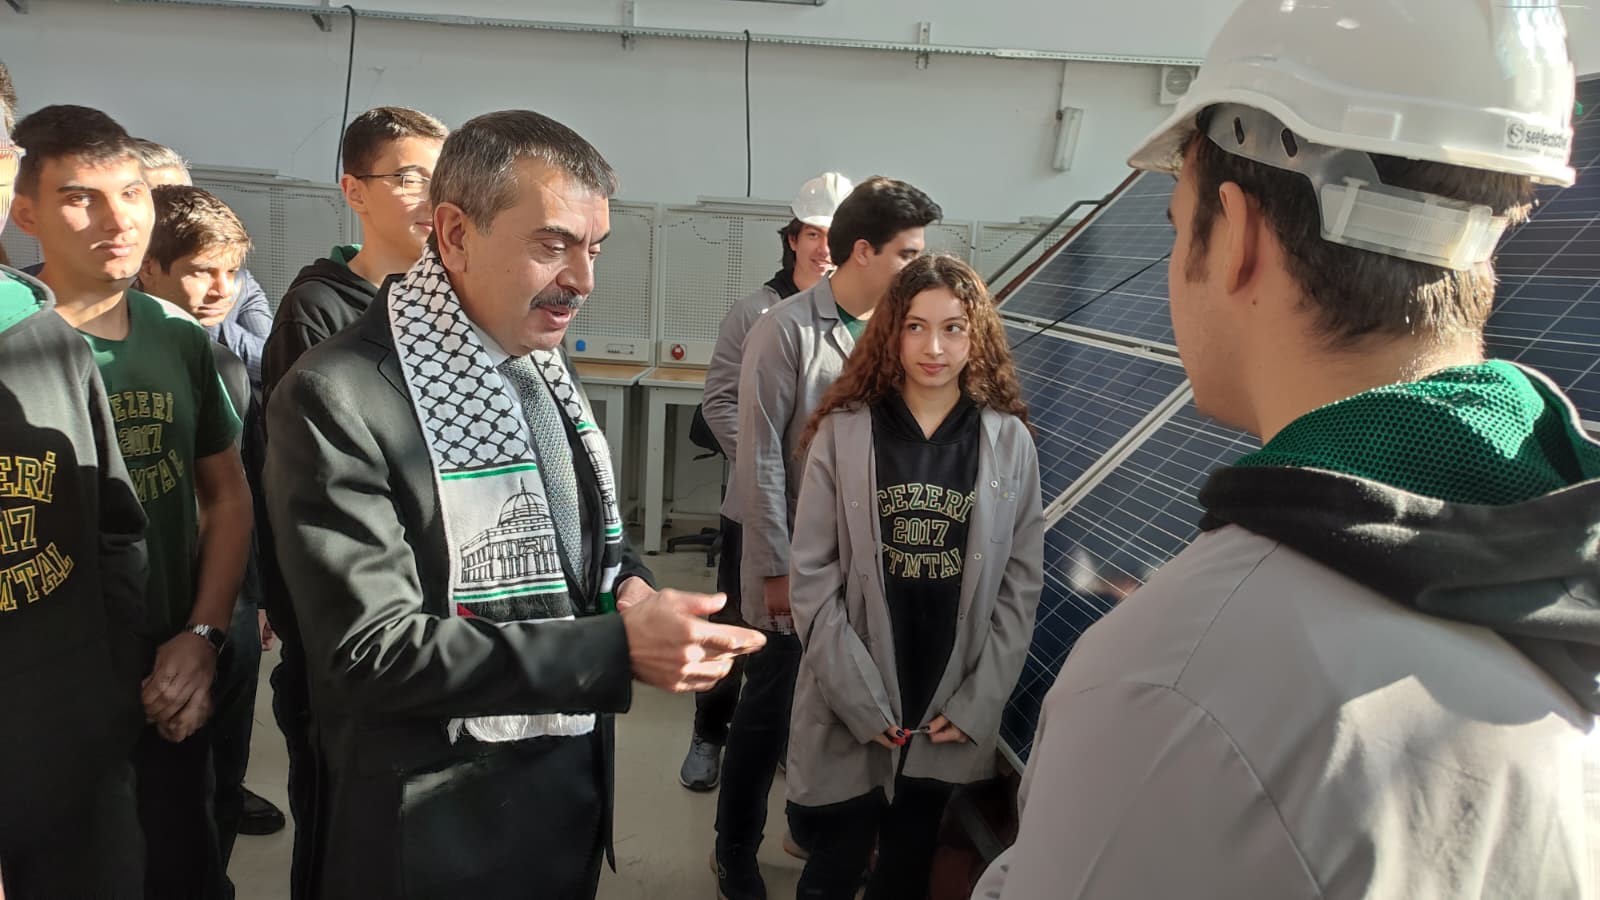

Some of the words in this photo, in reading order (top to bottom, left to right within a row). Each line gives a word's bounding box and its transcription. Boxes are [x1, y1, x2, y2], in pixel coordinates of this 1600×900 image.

[108, 391, 174, 423] EZERİ
[118, 424, 162, 457] 2017
[0, 451, 56, 503] ERİ
[129, 449, 184, 502] MTAL
[877, 483, 976, 523] CEZERİ
[0, 505, 37, 554] 17
[893, 517, 950, 546] 2017
[0, 542, 74, 611] MTAL
